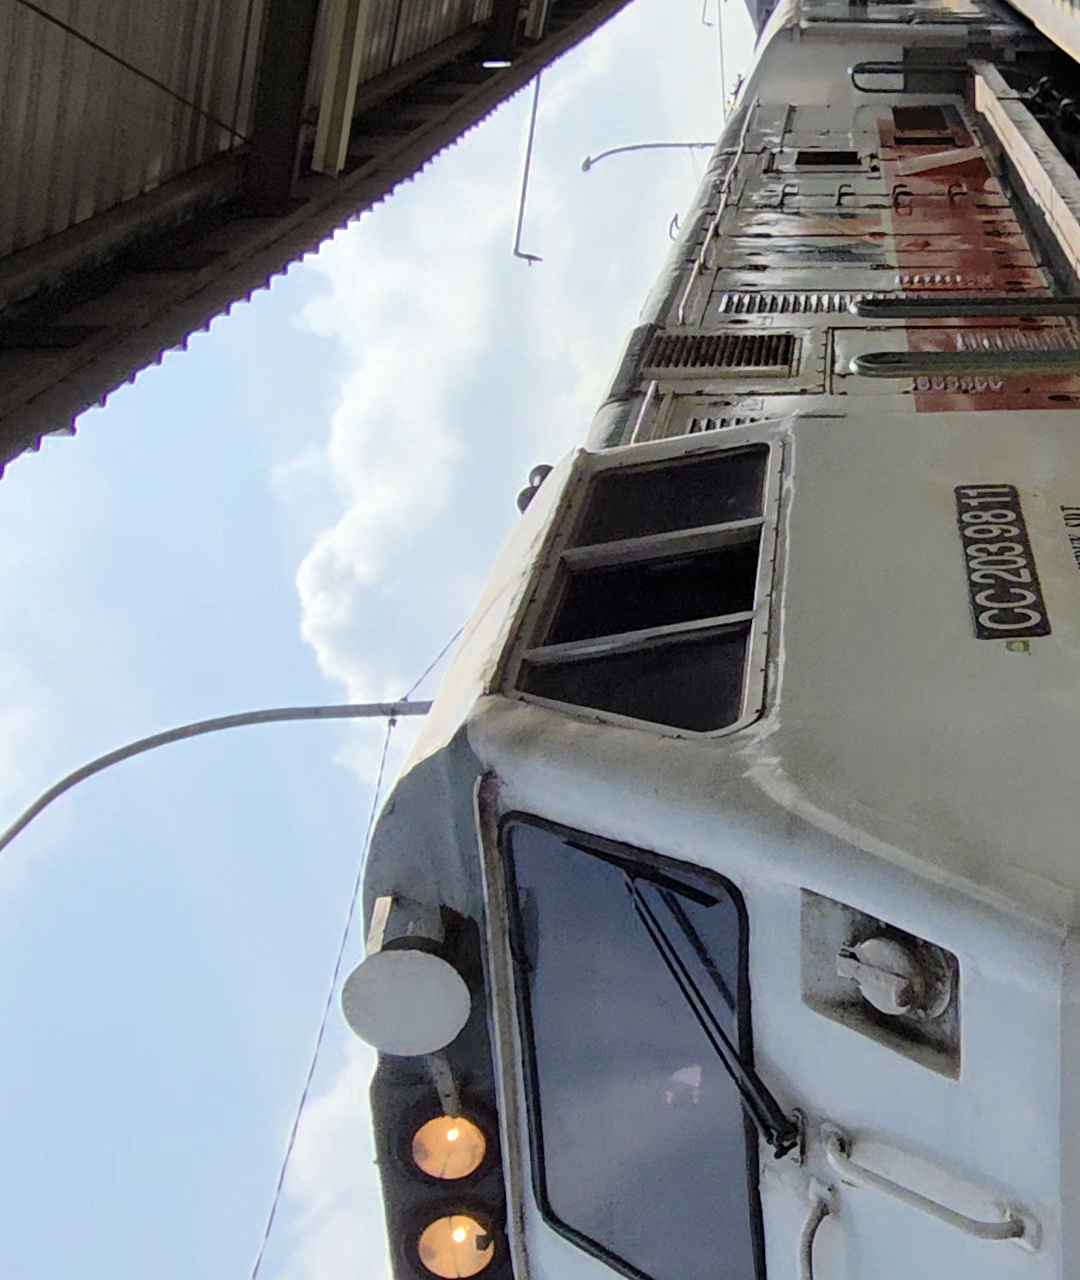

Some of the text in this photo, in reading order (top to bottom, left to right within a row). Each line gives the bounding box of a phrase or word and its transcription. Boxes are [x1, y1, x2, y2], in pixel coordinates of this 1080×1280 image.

[960, 487, 1042, 630] CC 203 98 11
